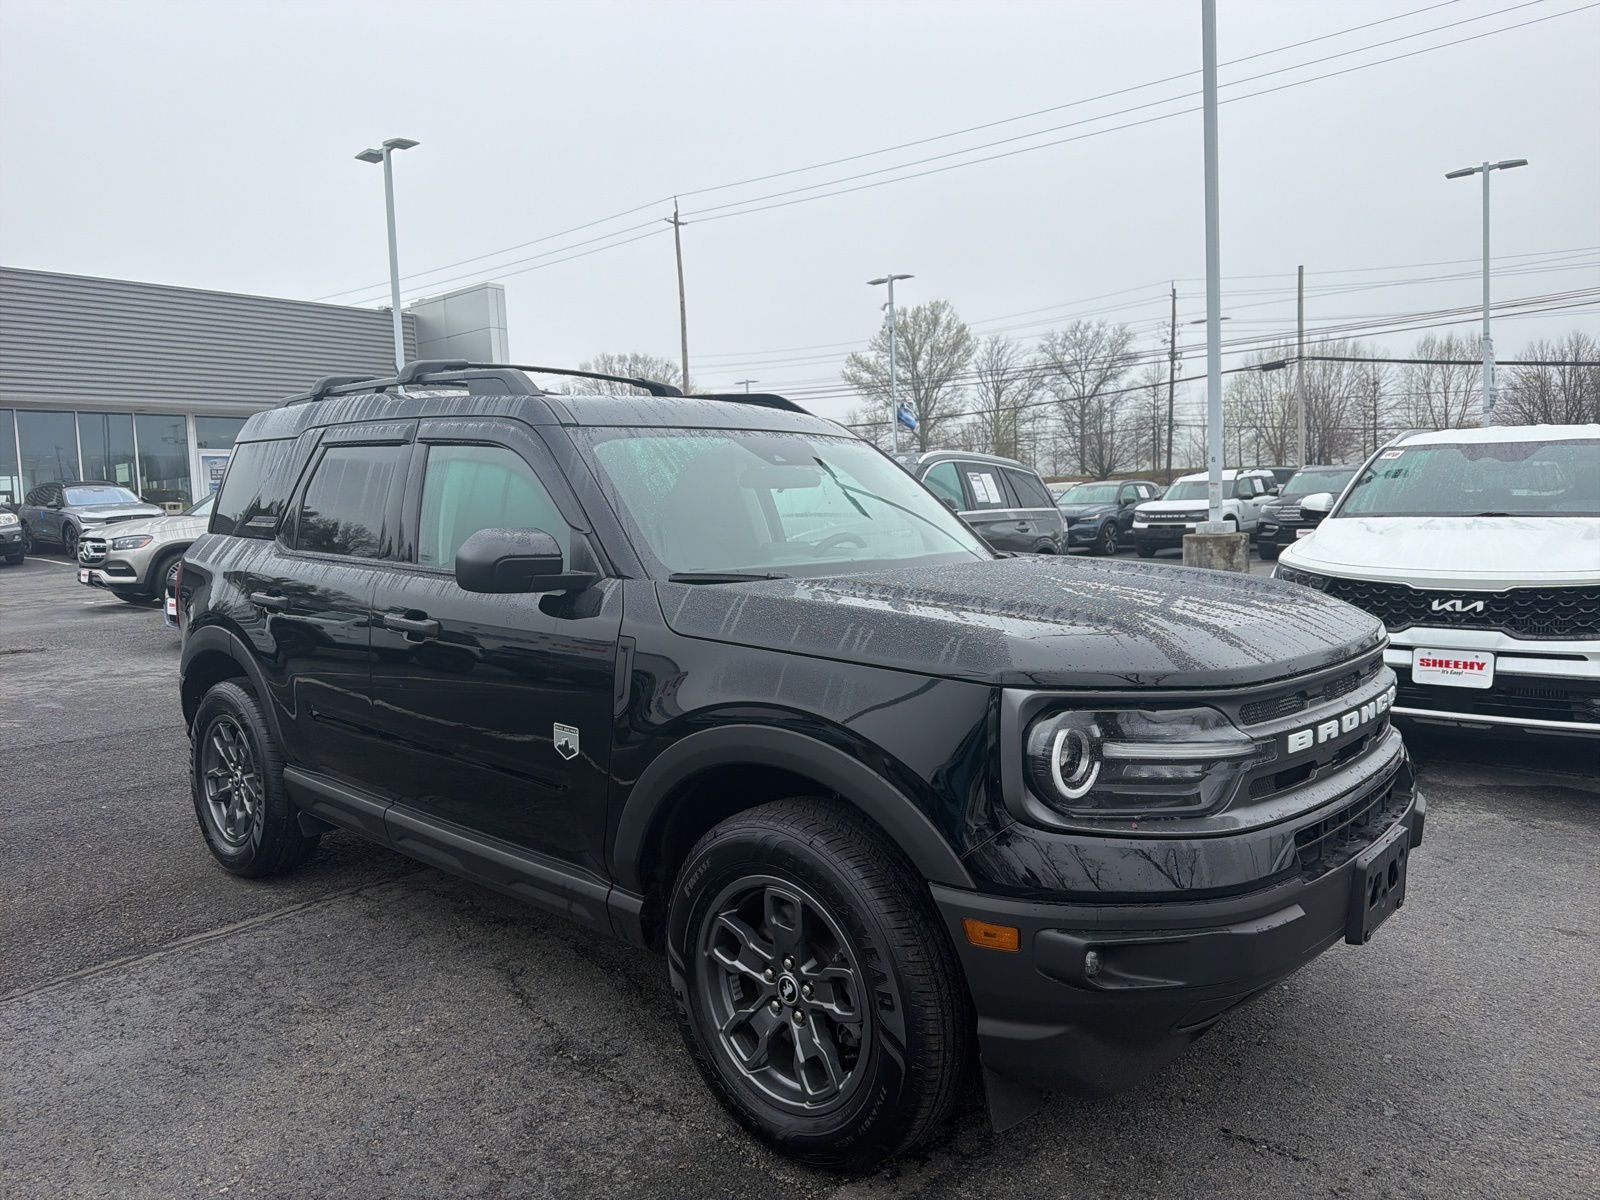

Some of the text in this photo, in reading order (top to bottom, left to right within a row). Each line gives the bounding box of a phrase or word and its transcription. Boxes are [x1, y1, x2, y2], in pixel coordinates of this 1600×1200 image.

[1432, 599, 1484, 612] KIA
[1419, 658, 1486, 671] SHEEHY
[1288, 686, 1396, 754] BRONCO
